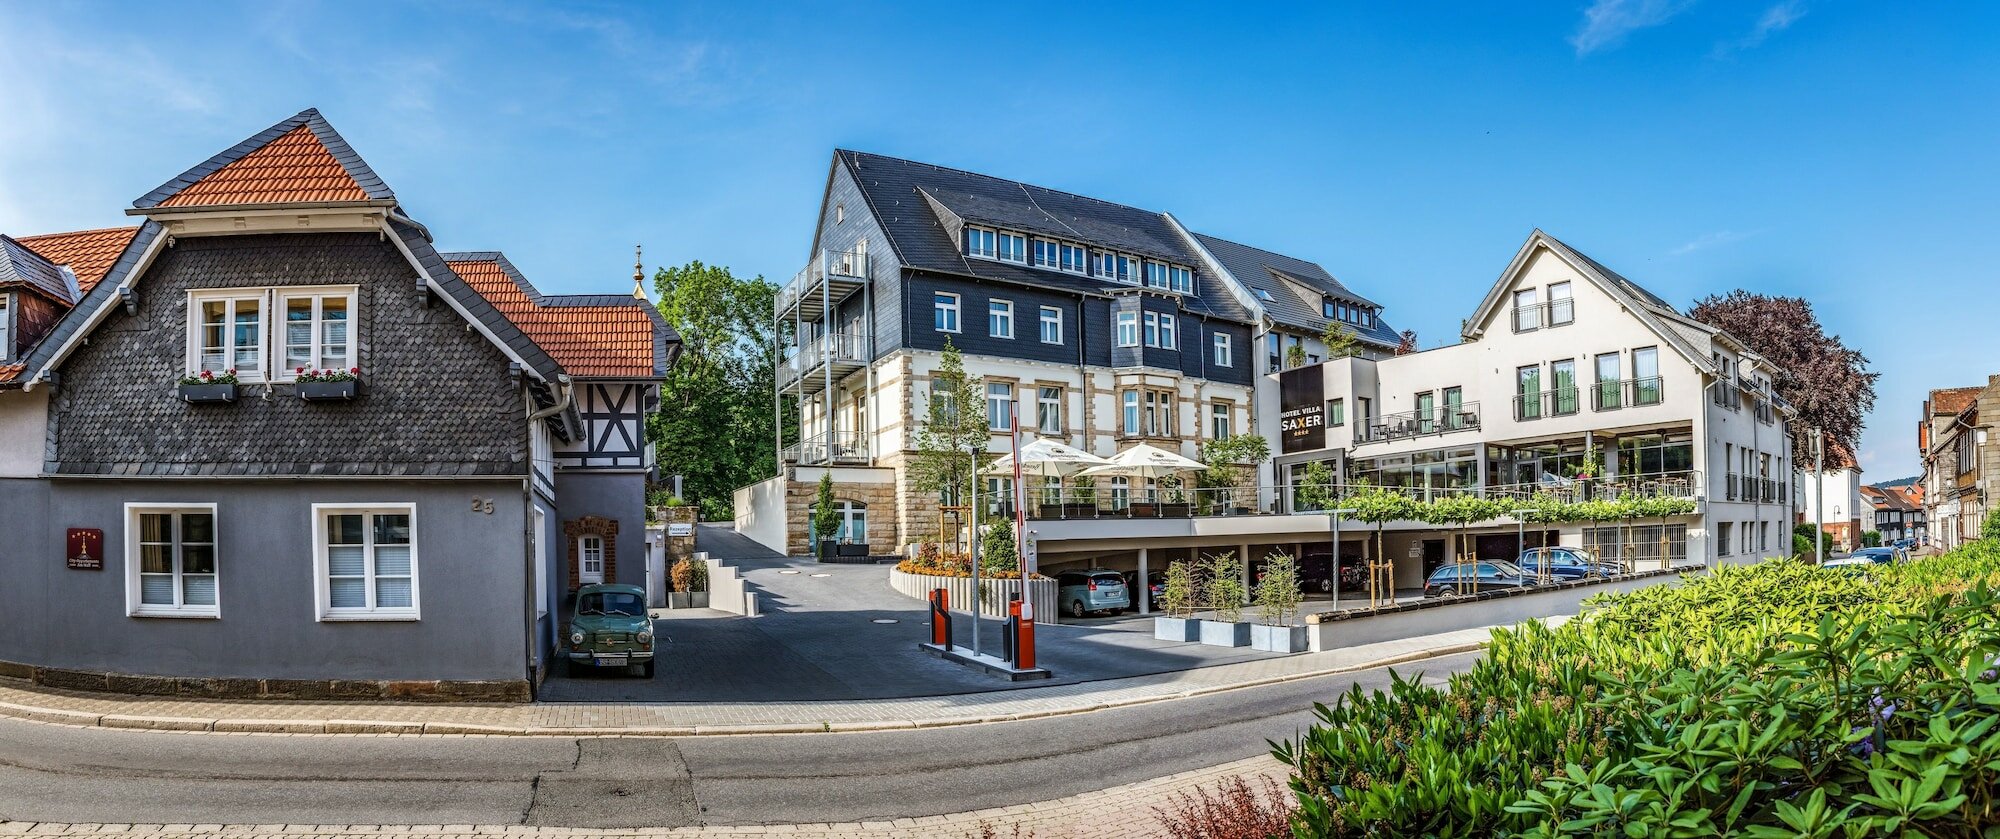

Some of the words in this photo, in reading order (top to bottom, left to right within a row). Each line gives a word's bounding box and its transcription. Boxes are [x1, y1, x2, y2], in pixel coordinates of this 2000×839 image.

[1281, 410, 1300, 418] HOTEL
[1302, 406, 1320, 414] VILLA
[1282, 415, 1321, 431] SAXER
[472, 495, 494, 514] 25
